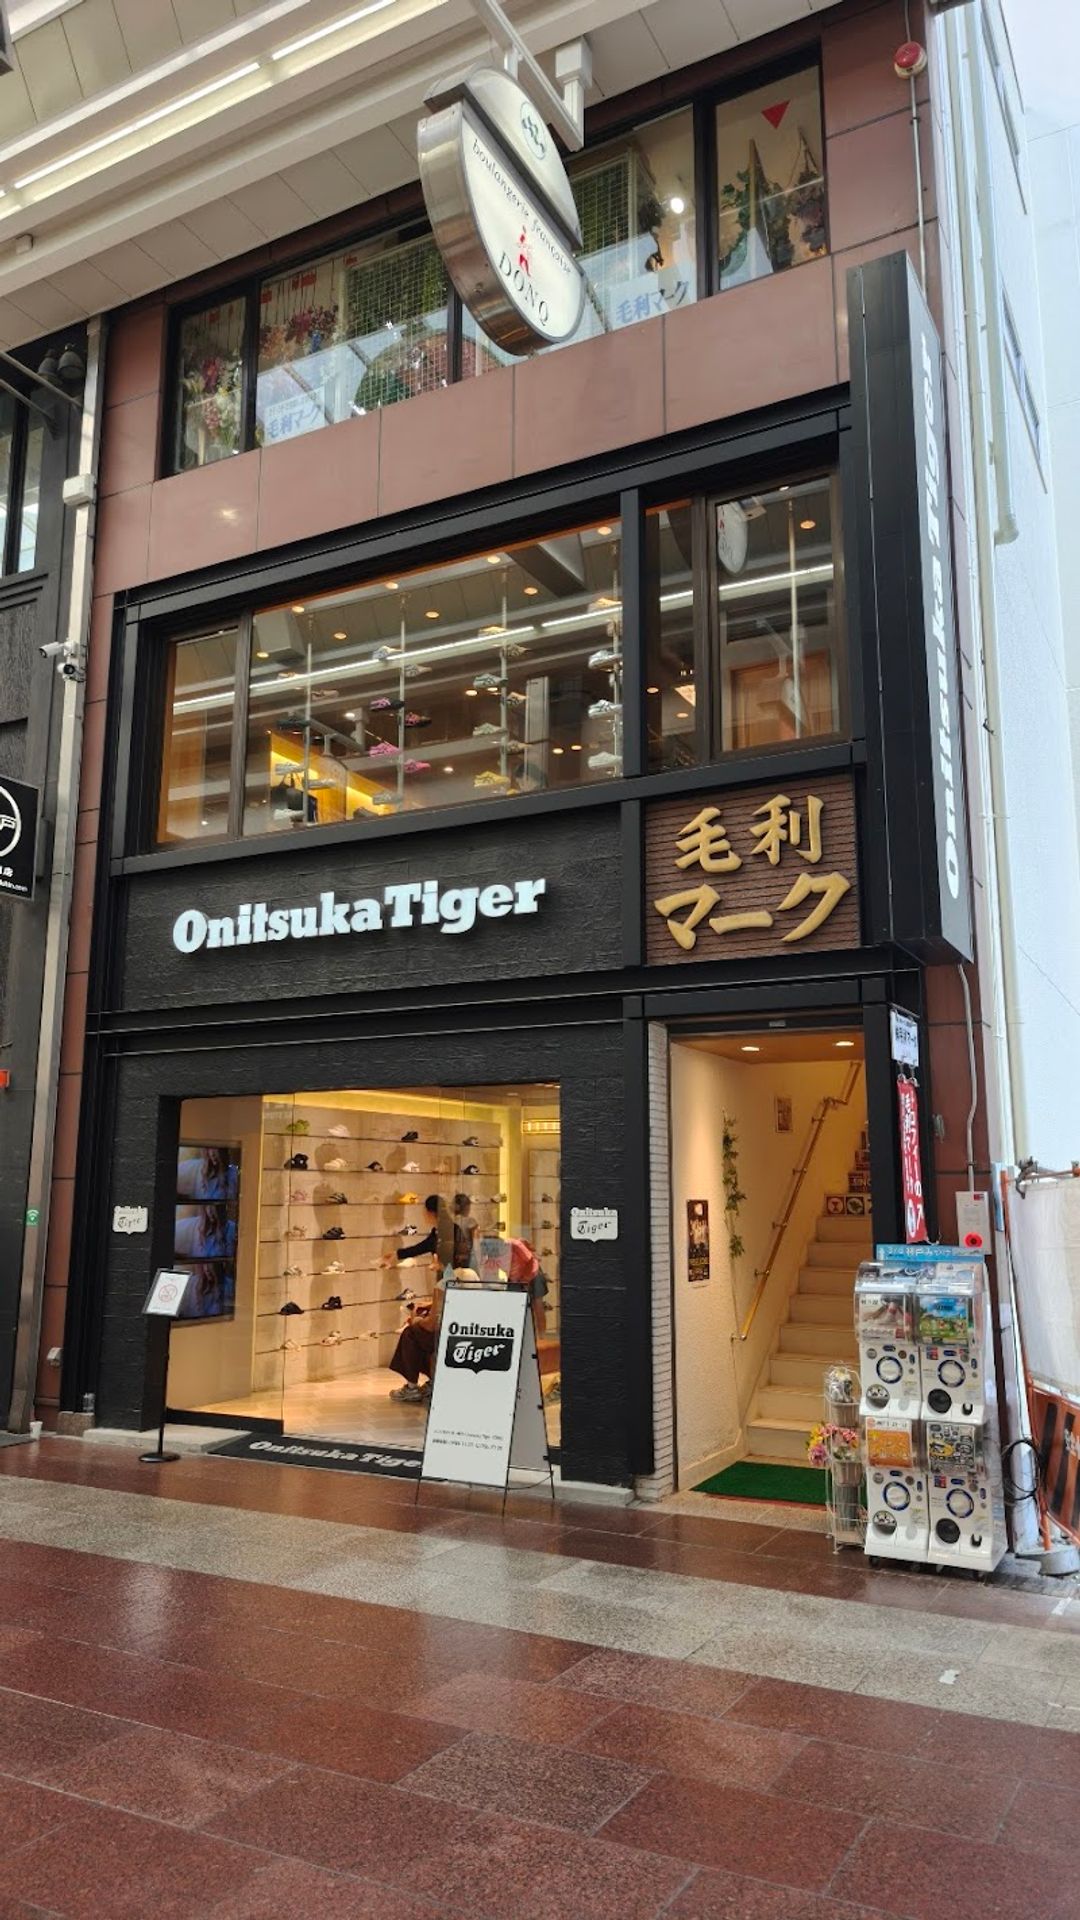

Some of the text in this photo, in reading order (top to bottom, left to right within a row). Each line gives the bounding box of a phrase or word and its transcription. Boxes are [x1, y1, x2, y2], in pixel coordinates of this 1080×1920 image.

[499, 252, 549, 326] DONQ
[615, 280, 690, 324] 毛利マーク
[921, 332, 961, 900] Onitsuka Tiger
[675, 794, 824, 873] 毛利
[172, 878, 546, 954] Onitsuka Tiger
[654, 871, 850, 950] マーク
[577, 1220, 612, 1235] Tiger
[448, 1322, 515, 1338] Onitsuka
[453, 1340, 506, 1363] Tiger
[249, 1440, 422, 1467] Onitsuka Tige
